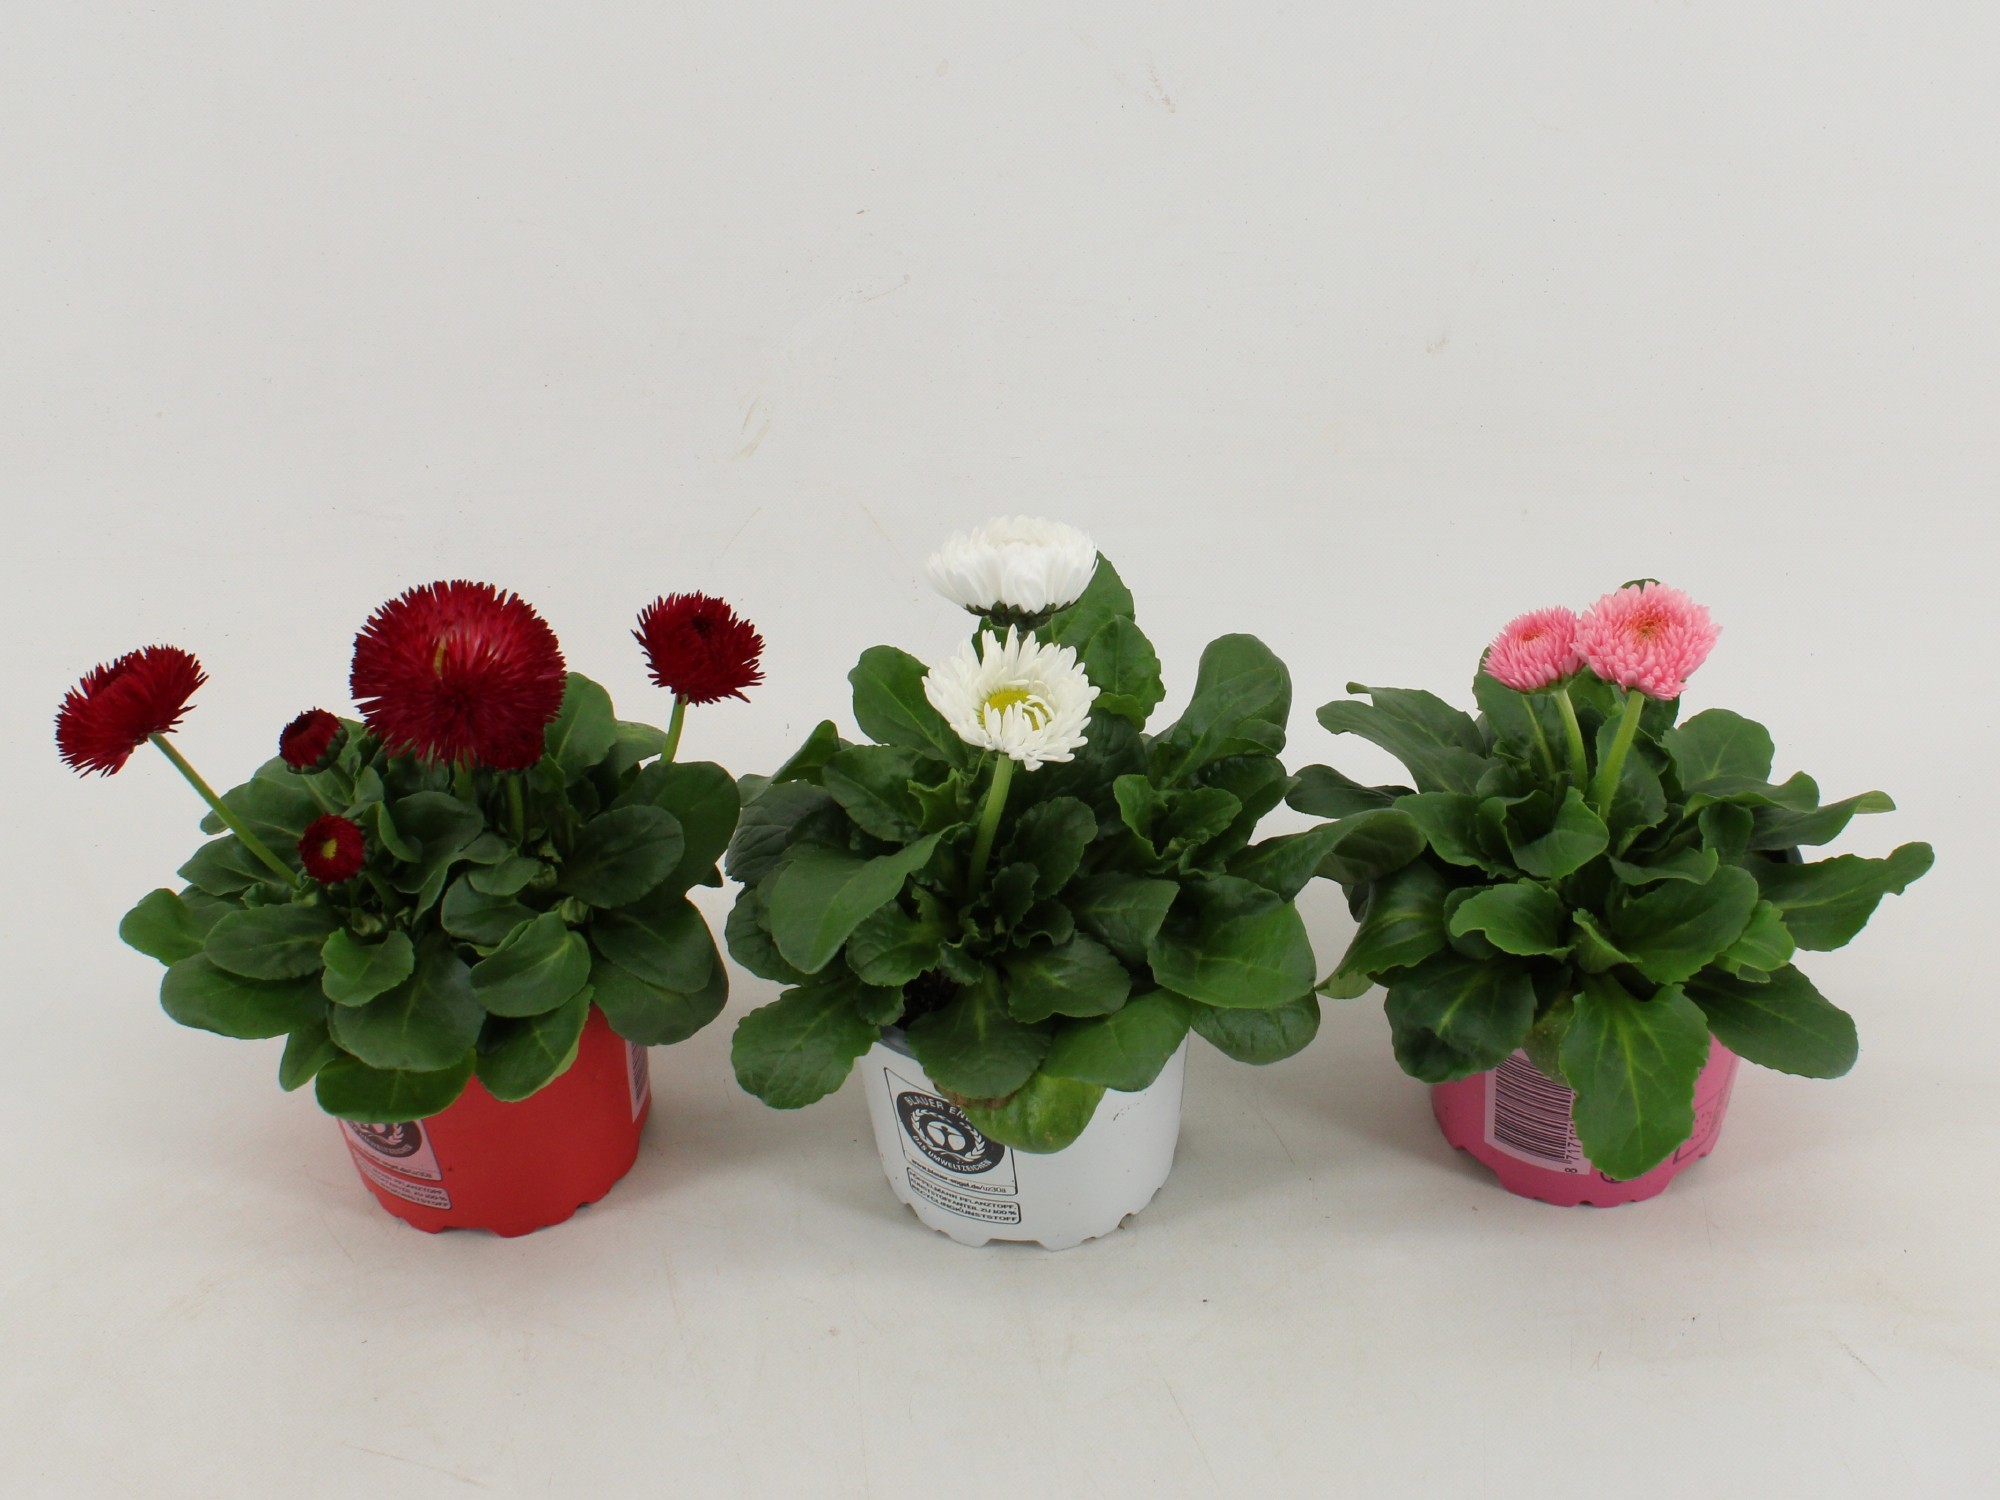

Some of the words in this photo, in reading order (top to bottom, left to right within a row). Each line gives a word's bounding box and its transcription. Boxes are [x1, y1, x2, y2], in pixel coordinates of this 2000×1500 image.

[904, 1096, 944, 1111] BLAUER
[949, 1107, 970, 1122] EN
[913, 1135, 926, 1151] DAS
[928, 1151, 992, 1172] UMWELTZEICHEN
